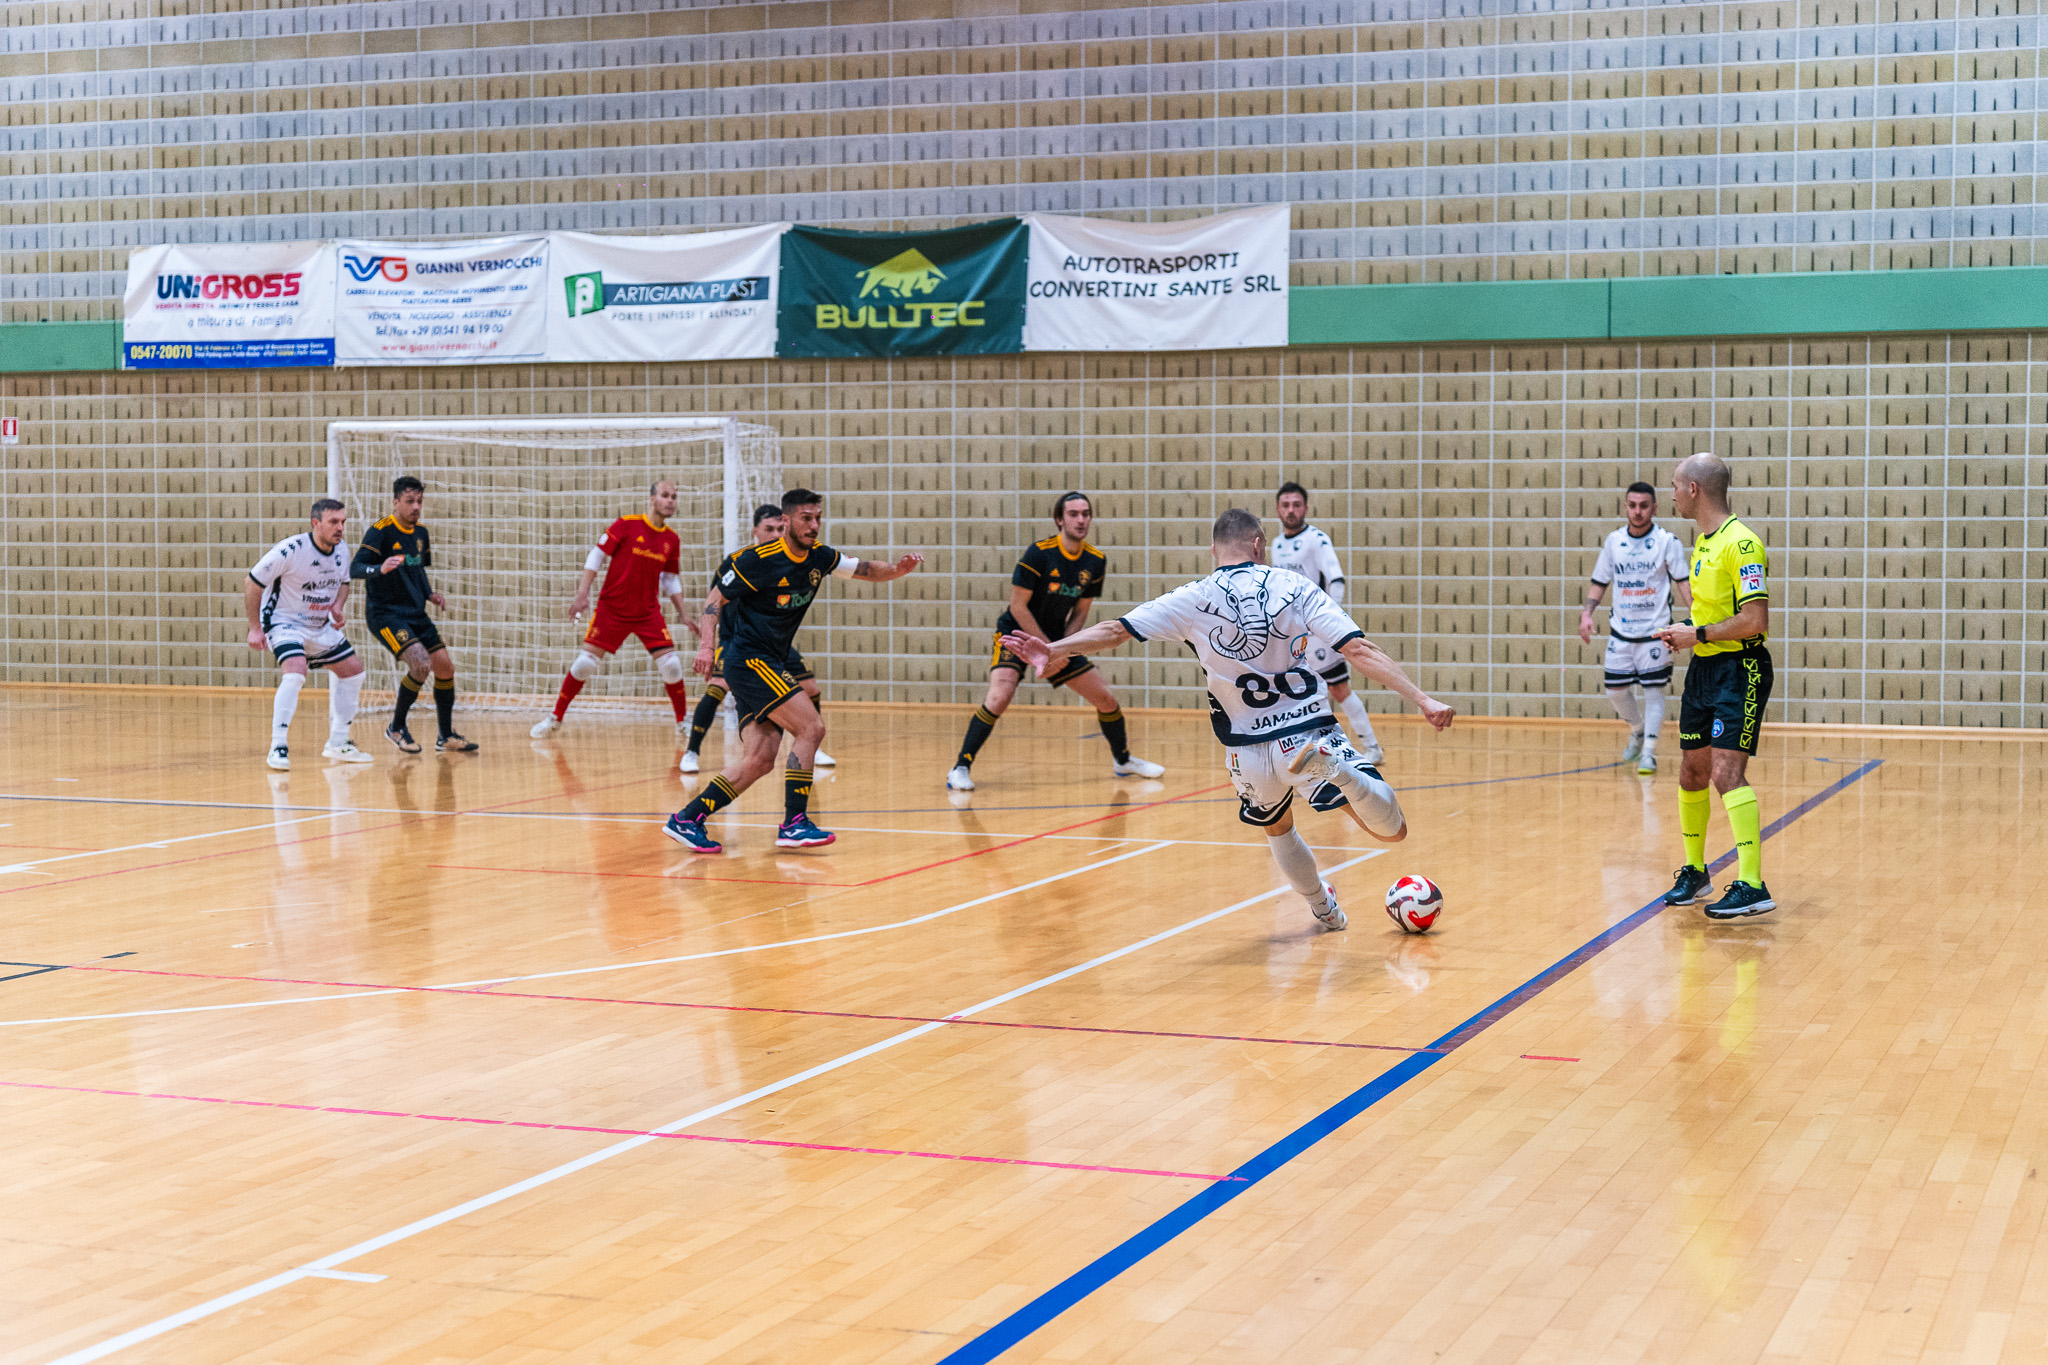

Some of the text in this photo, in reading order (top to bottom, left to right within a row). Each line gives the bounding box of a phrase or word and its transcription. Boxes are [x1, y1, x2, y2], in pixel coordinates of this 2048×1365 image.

[415, 256, 543, 275] GIANNI VERNOCCHI
[1063, 252, 1239, 275] AUTOTRASPORTI
[613, 280, 759, 302] ARTIGIANA PLAST
[1029, 274, 1282, 298] CONVERTINI SANTE SRL
[611, 311, 643, 321] PORTE
[657, 310, 695, 320] INFISSI
[816, 300, 985, 330] BULLTEC
[131, 344, 193, 360] 0547-20070
[1625, 561, 1657, 570] ALPHA
[1740, 564, 1763, 576] NET
[1235, 666, 1318, 709] 80
